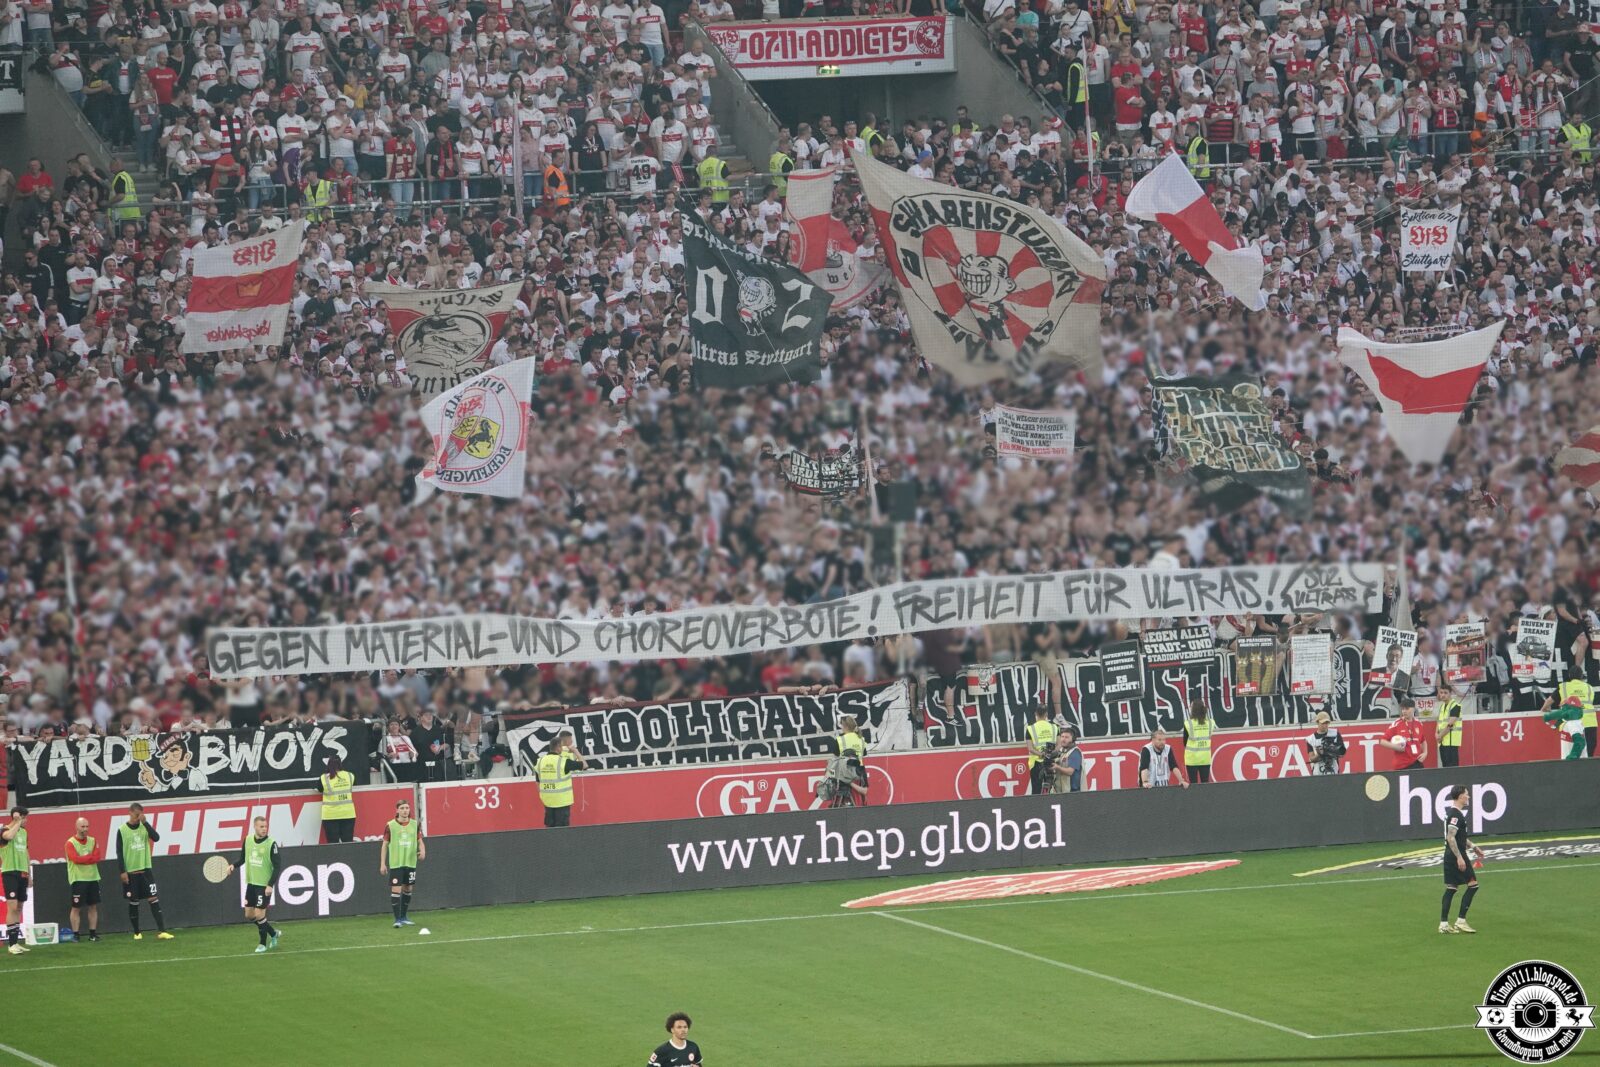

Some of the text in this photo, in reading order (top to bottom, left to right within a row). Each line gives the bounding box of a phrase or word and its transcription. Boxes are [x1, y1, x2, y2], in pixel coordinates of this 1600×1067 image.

[749, 30, 798, 60] 0711
[806, 26, 907, 58] ADDICTS
[632, 164, 651, 180] 49
[1409, 225, 1449, 246] VfB
[1402, 252, 1451, 269] Stuttgart
[1294, 586, 1358, 607] ULTRAS
[208, 629, 330, 675] GEGEN
[892, 575, 1055, 630] FREIHEIT
[1063, 570, 1132, 614] FÜR
[1140, 567, 1280, 613] ULTRAS!
[1521, 620, 1545, 628] DRIVEN
[1181, 626, 1210, 640] ALLE
[1381, 628, 1415, 641] VOM WIR
[1524, 627, 1550, 636] DREAMS
[1144, 638, 1213, 654] STADT- UND
[1381, 636, 1412, 648] ZUM ICH
[1147, 649, 1215, 663] STADIONVERBOTE!
[1105, 680, 1141, 694] REICHT!
[1116, 674, 1128, 684] ES
[565, 689, 871, 757] HOOLIGANS
[1500, 719, 1525, 742] 34
[18, 726, 348, 785] YARD BWOYS
[475, 787, 500, 808] 33
[720, 775, 869, 815] GAZ
[1399, 774, 1507, 833] hep
[105, 801, 322, 860] HEIM
[667, 804, 1066, 873] www.hep.global
[257, 894, 263, 906] 5
